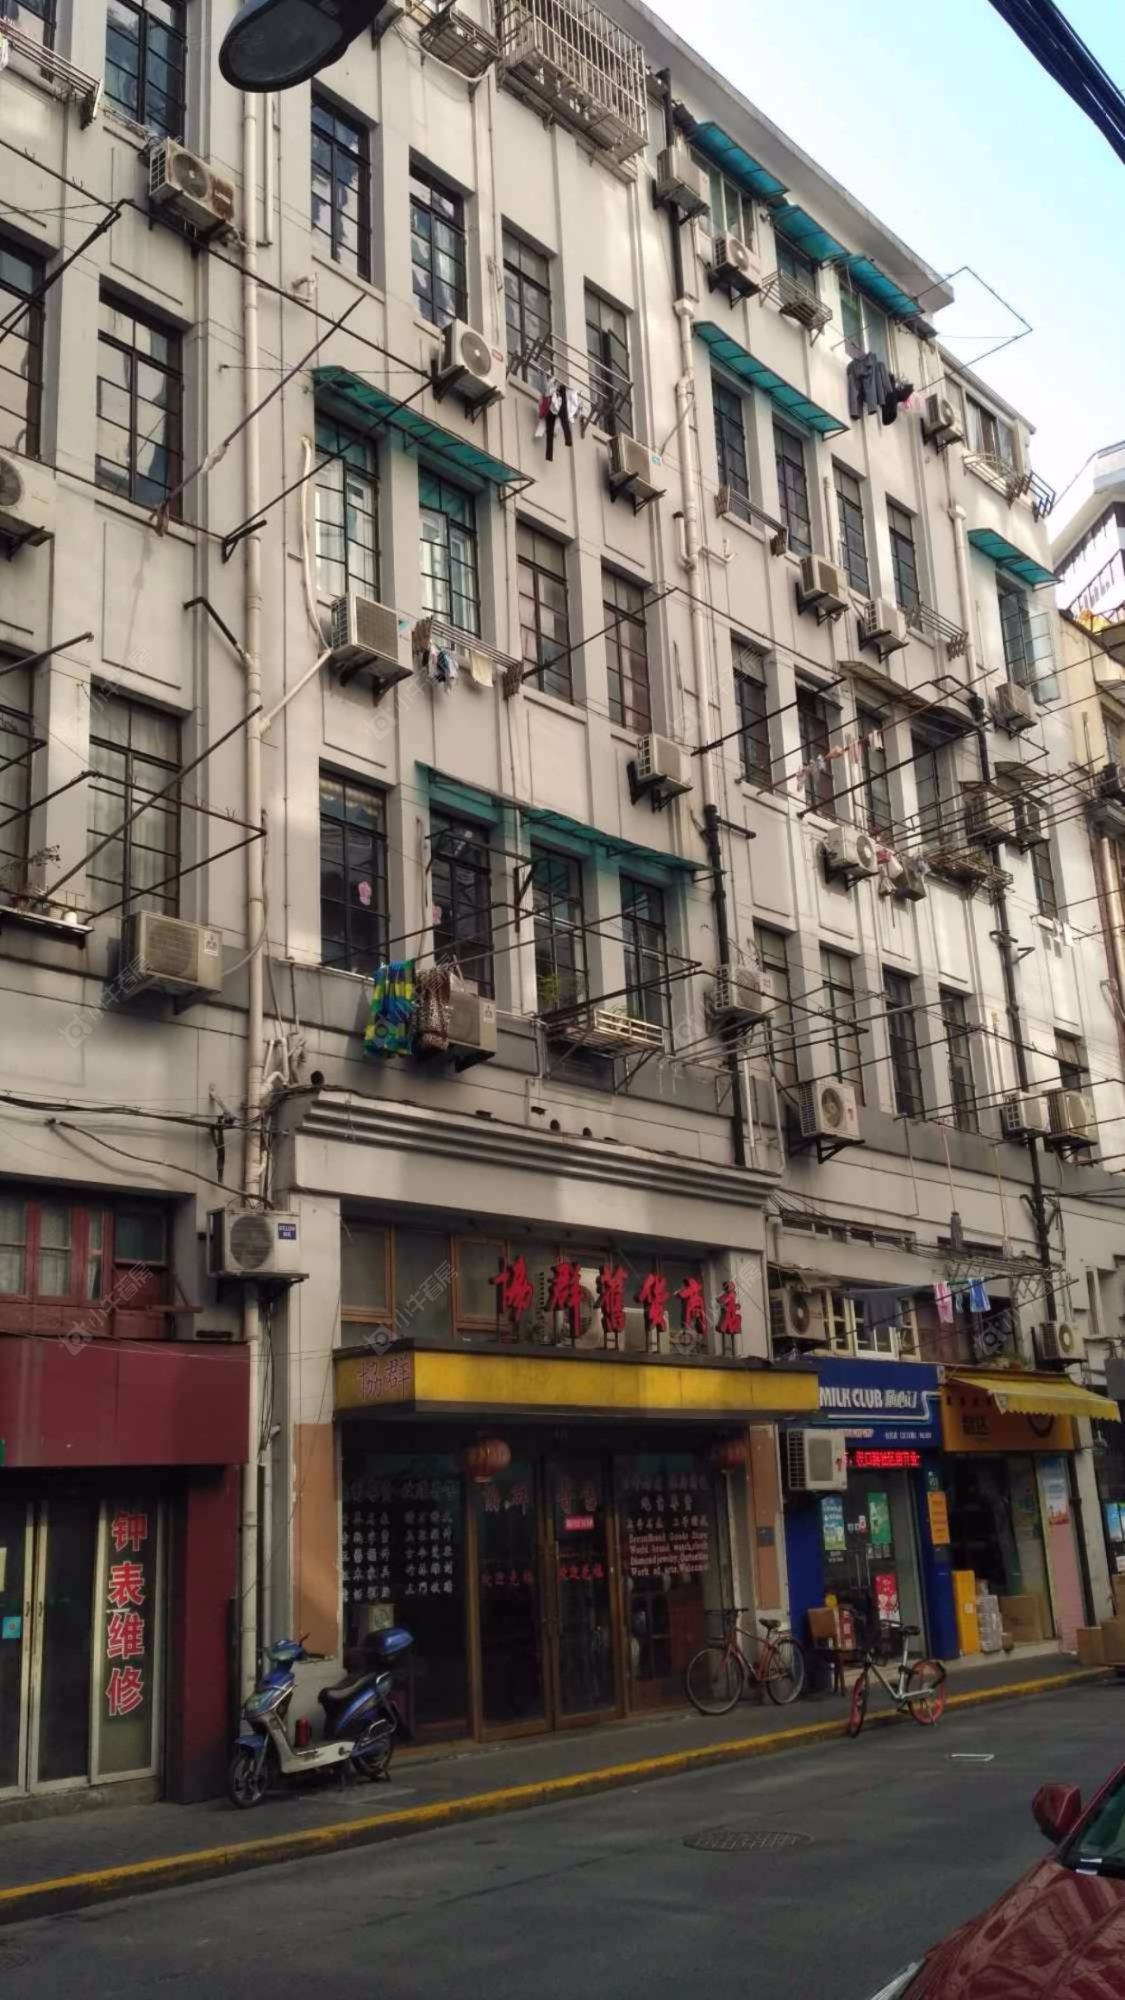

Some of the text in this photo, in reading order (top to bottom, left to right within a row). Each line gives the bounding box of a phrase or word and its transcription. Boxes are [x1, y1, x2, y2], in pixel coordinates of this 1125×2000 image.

[820, 1387, 850, 1408] MILK
[852, 1388, 883, 1408] CLUB
[105, 1509, 149, 1717] 钟表维修
